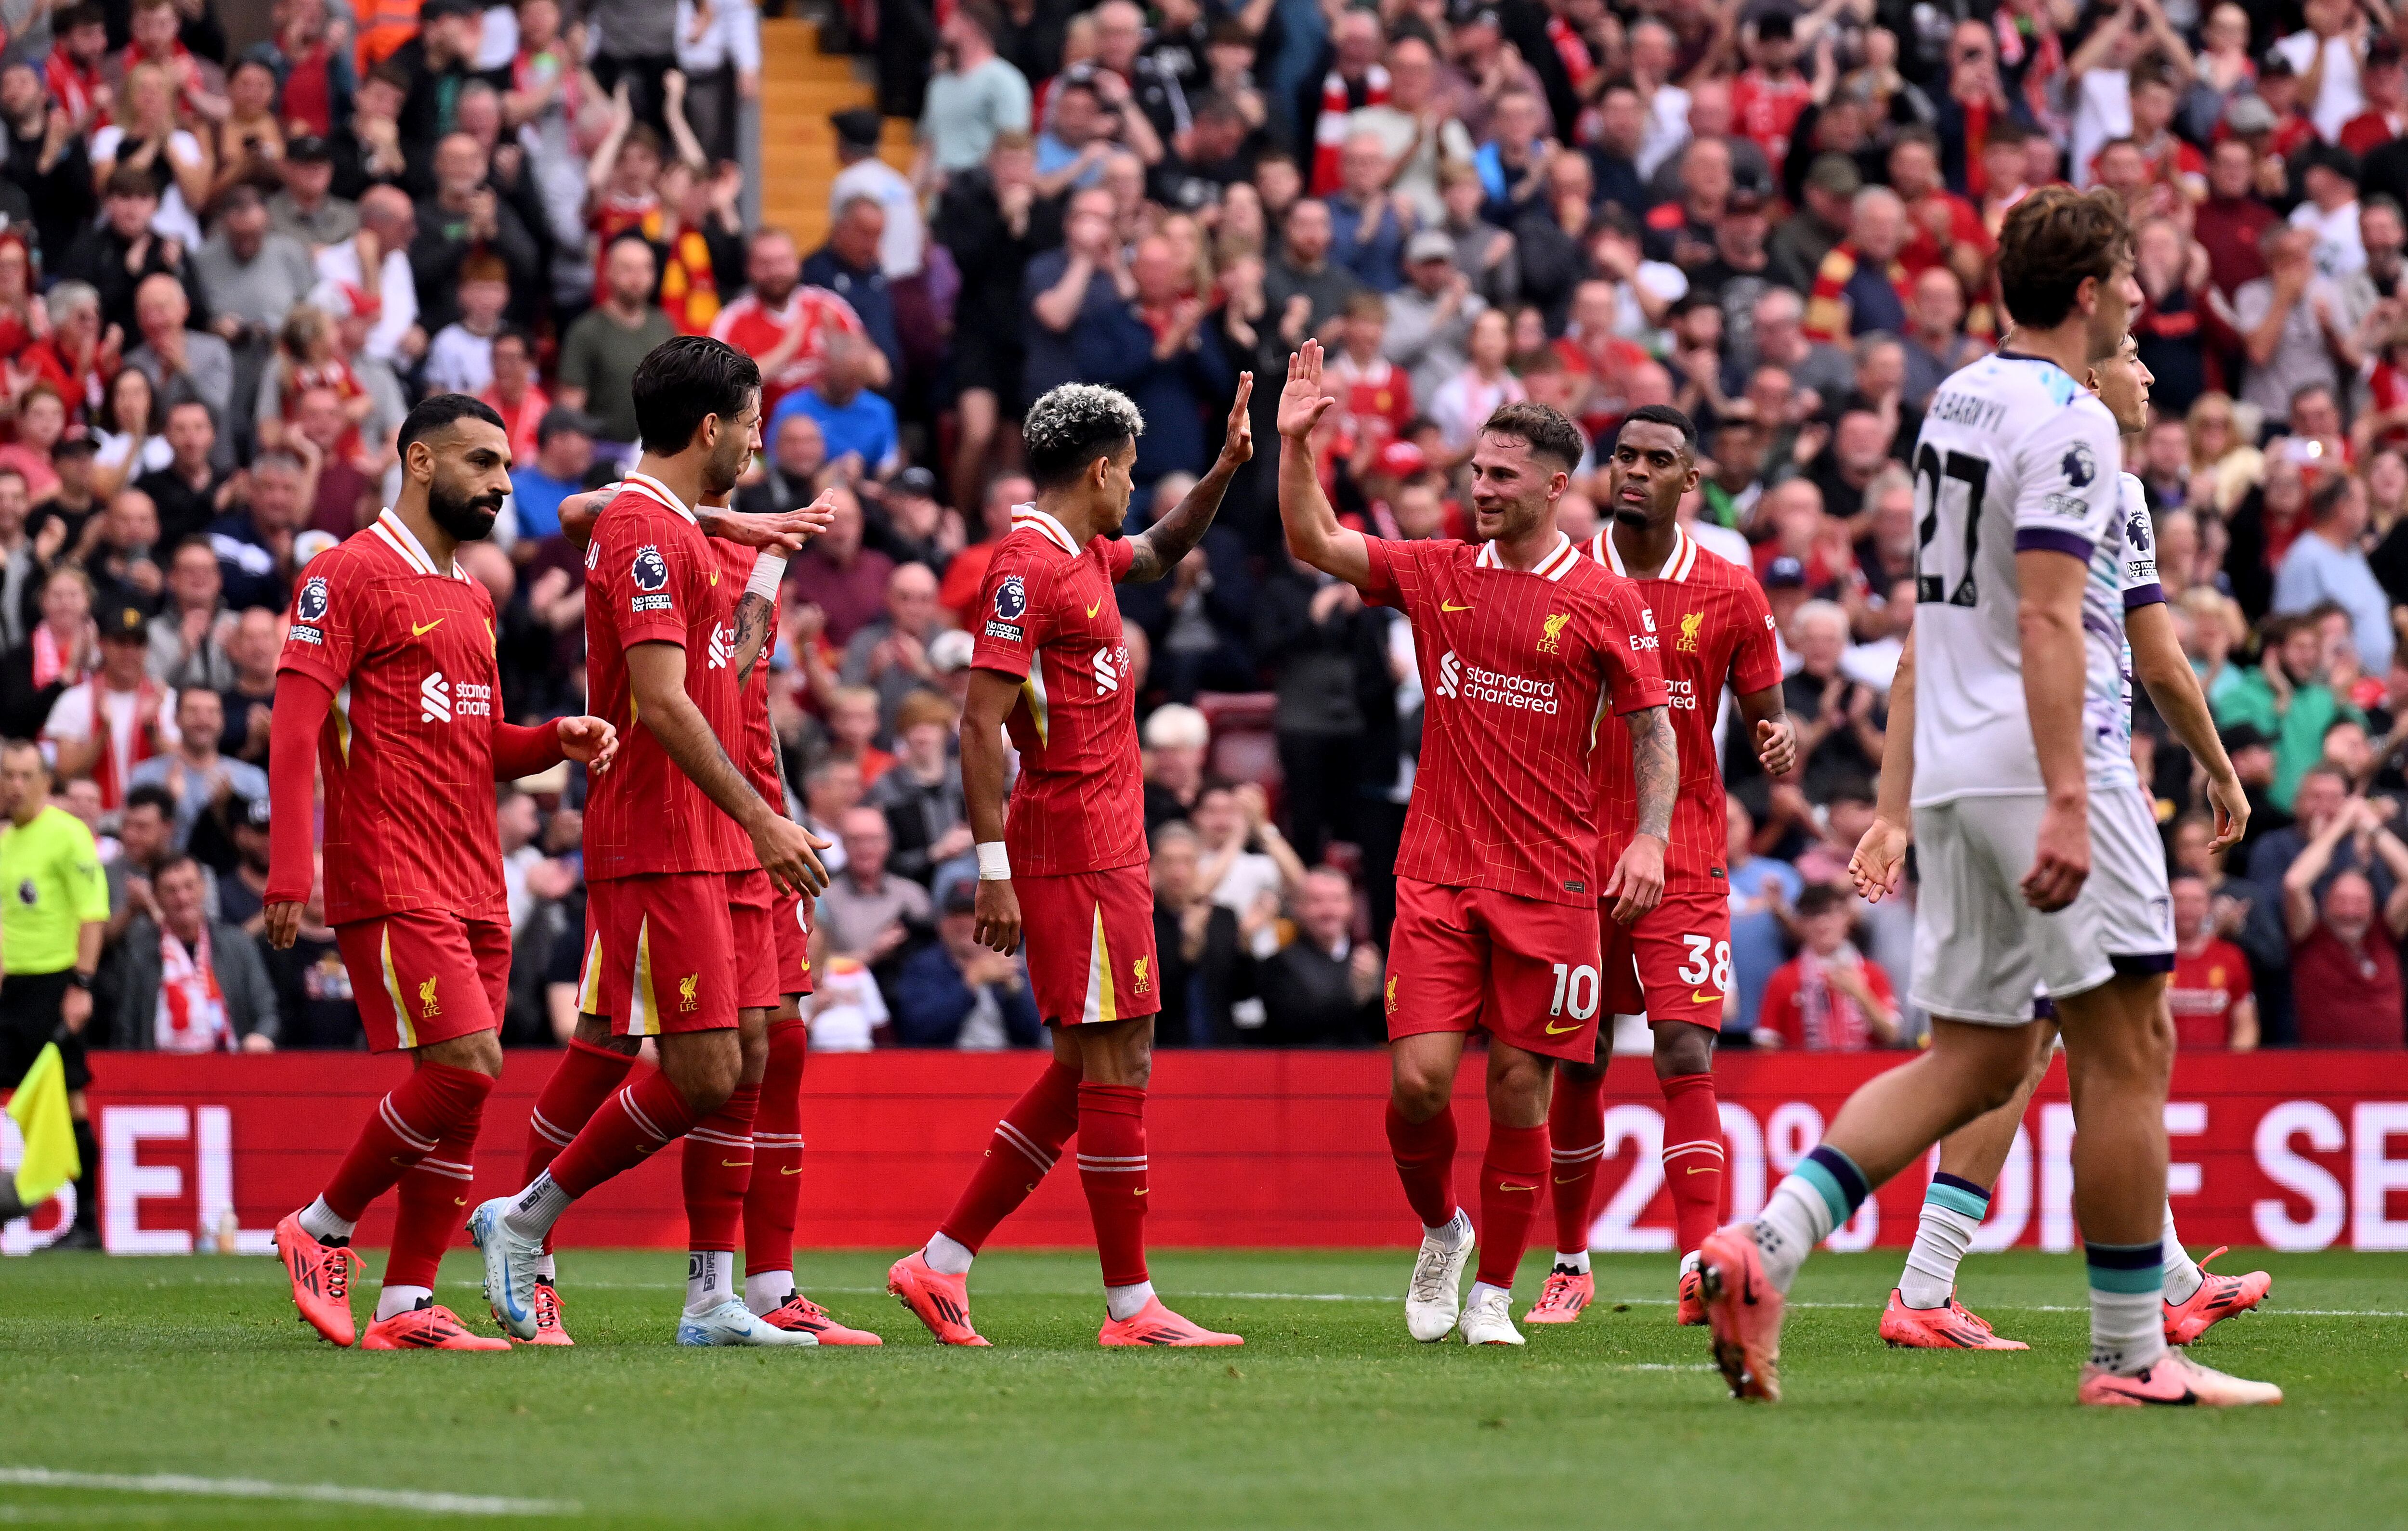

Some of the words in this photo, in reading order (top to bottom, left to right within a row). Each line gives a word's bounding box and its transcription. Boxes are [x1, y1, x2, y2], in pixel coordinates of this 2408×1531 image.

[1914, 442, 1990, 607] 27
[2127, 562, 2140, 570] No
[631, 597, 644, 605] No
[645, 595, 670, 603] room
[645, 602, 673, 610] racism
[986, 620, 997, 629] No
[996, 623, 1020, 635] room
[995, 630, 1021, 643] racism
[1466, 666, 1555, 697] standard
[1464, 683, 1558, 715] chartered
[1678, 934, 1731, 992] 38
[1550, 963, 1599, 1020] 10
[2251, 1099, 2408, 1253] SE
[1452, 1215, 1462, 1231] GN
